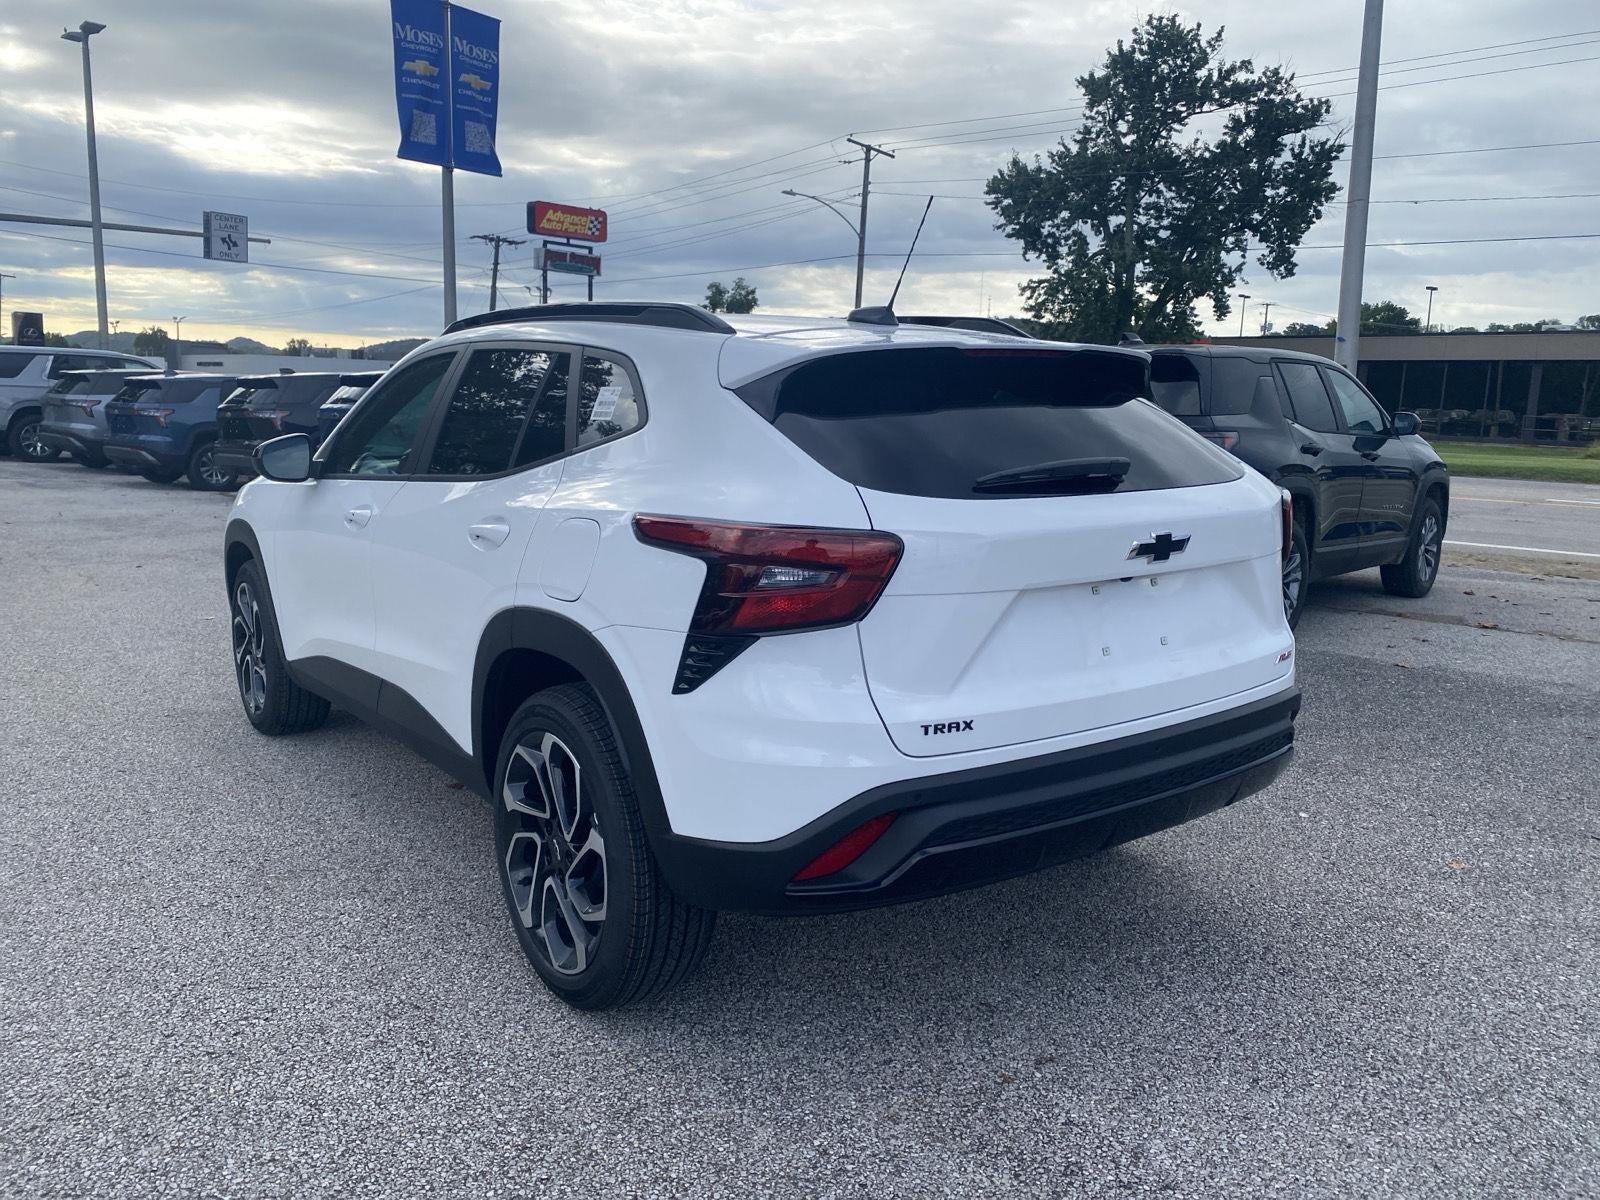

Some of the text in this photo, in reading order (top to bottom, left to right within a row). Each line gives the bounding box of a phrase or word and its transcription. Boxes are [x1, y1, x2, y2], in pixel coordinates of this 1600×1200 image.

[394, 22, 444, 49] MOSES
[401, 41, 438, 54] CHEVROLET
[453, 36, 498, 64] MOSES
[402, 77, 440, 89] CHEVROLET
[458, 88, 492, 103] CHEVROLET
[214, 214, 244, 224] CENTER
[545, 208, 587, 226] Advance
[218, 222, 240, 231] LANE
[539, 217, 587, 235] Auto Parts
[219, 250, 240, 260] ONLY
[920, 719, 974, 736] TRAX
